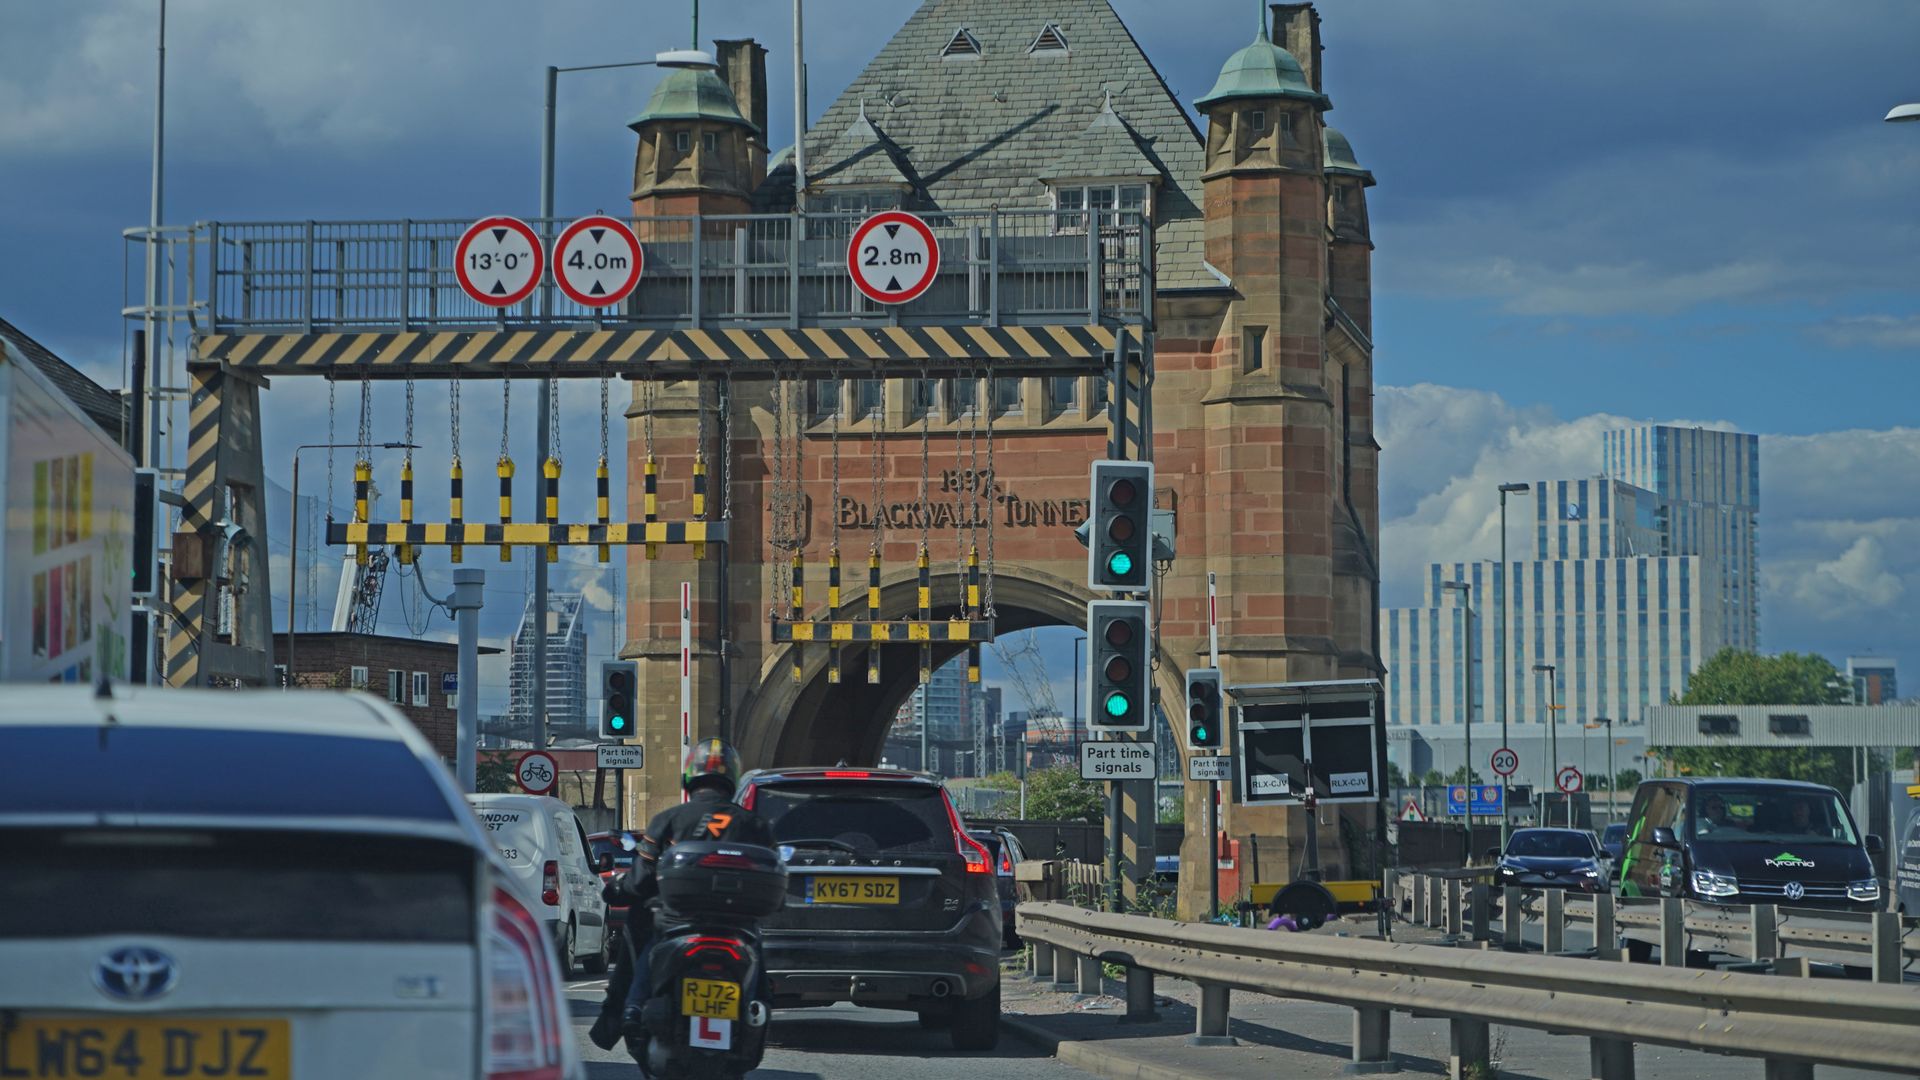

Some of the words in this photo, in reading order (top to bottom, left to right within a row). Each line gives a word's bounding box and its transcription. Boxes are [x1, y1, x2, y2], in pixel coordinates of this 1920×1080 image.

[567, 249, 627, 270] 4.0m
[863, 245, 922, 266] 2.8m
[1087, 747, 1116, 759] Part
[1121, 747, 1150, 759] time
[605, 757, 634, 766] signals
[1193, 760, 1209, 768] Part
[1212, 760, 1230, 768] time
[1495, 756, 1514, 768] 20
[1095, 761, 1142, 775] signals
[1197, 769, 1225, 777] signals
[1252, 779, 1288, 789] RLX-CJV
[1331, 778, 1367, 787] RLX-CJV
[804, 858, 902, 866] VOLVO
[1765, 859, 1815, 868] Pyramid
[817, 883, 860, 898] KY67
[863, 884, 896, 898] SDZ
[687, 982, 736, 1001] RJ72
[693, 999, 731, 1015] LHF
[162, 1029, 269, 1077] DJZ
